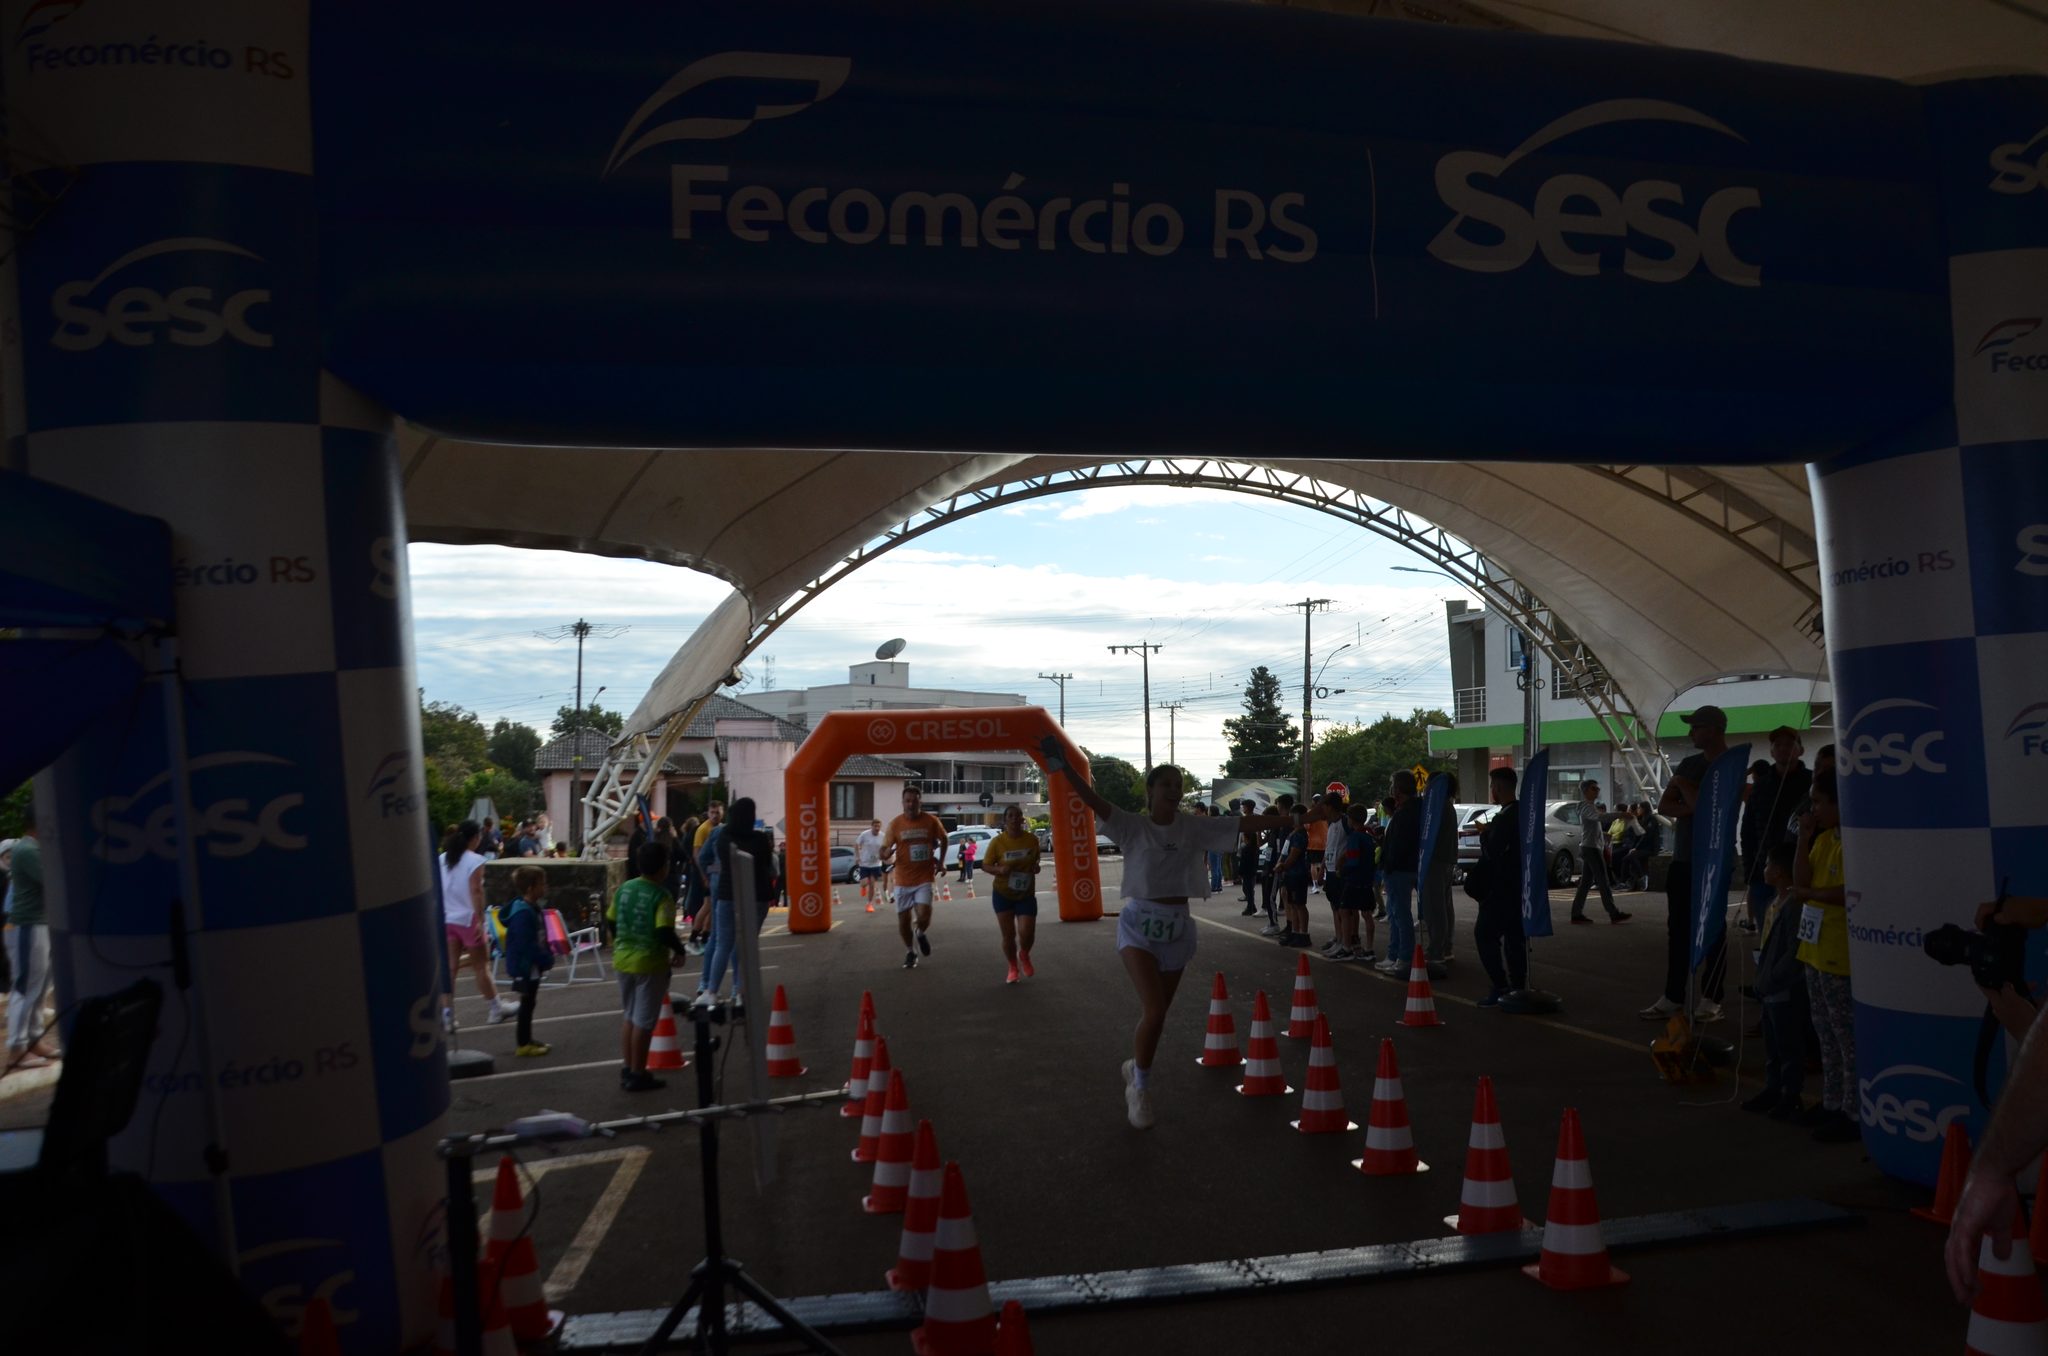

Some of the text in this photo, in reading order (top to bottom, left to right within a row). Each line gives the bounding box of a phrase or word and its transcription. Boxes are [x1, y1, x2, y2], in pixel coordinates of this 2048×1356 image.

[27, 35, 295, 80] Fecomércio RS
[670, 164, 1319, 263] Fecomércio RS
[1425, 149, 1763, 288] Sesc
[50, 280, 275, 352] Sesc
[173, 556, 316, 587] ércio RS
[1917, 550, 1956, 573] RS
[905, 718, 1010, 742] CRESOL
[799, 796, 818, 886] CRESOL
[1141, 917, 1175, 941] 131
[315, 1042, 358, 1076] RS
